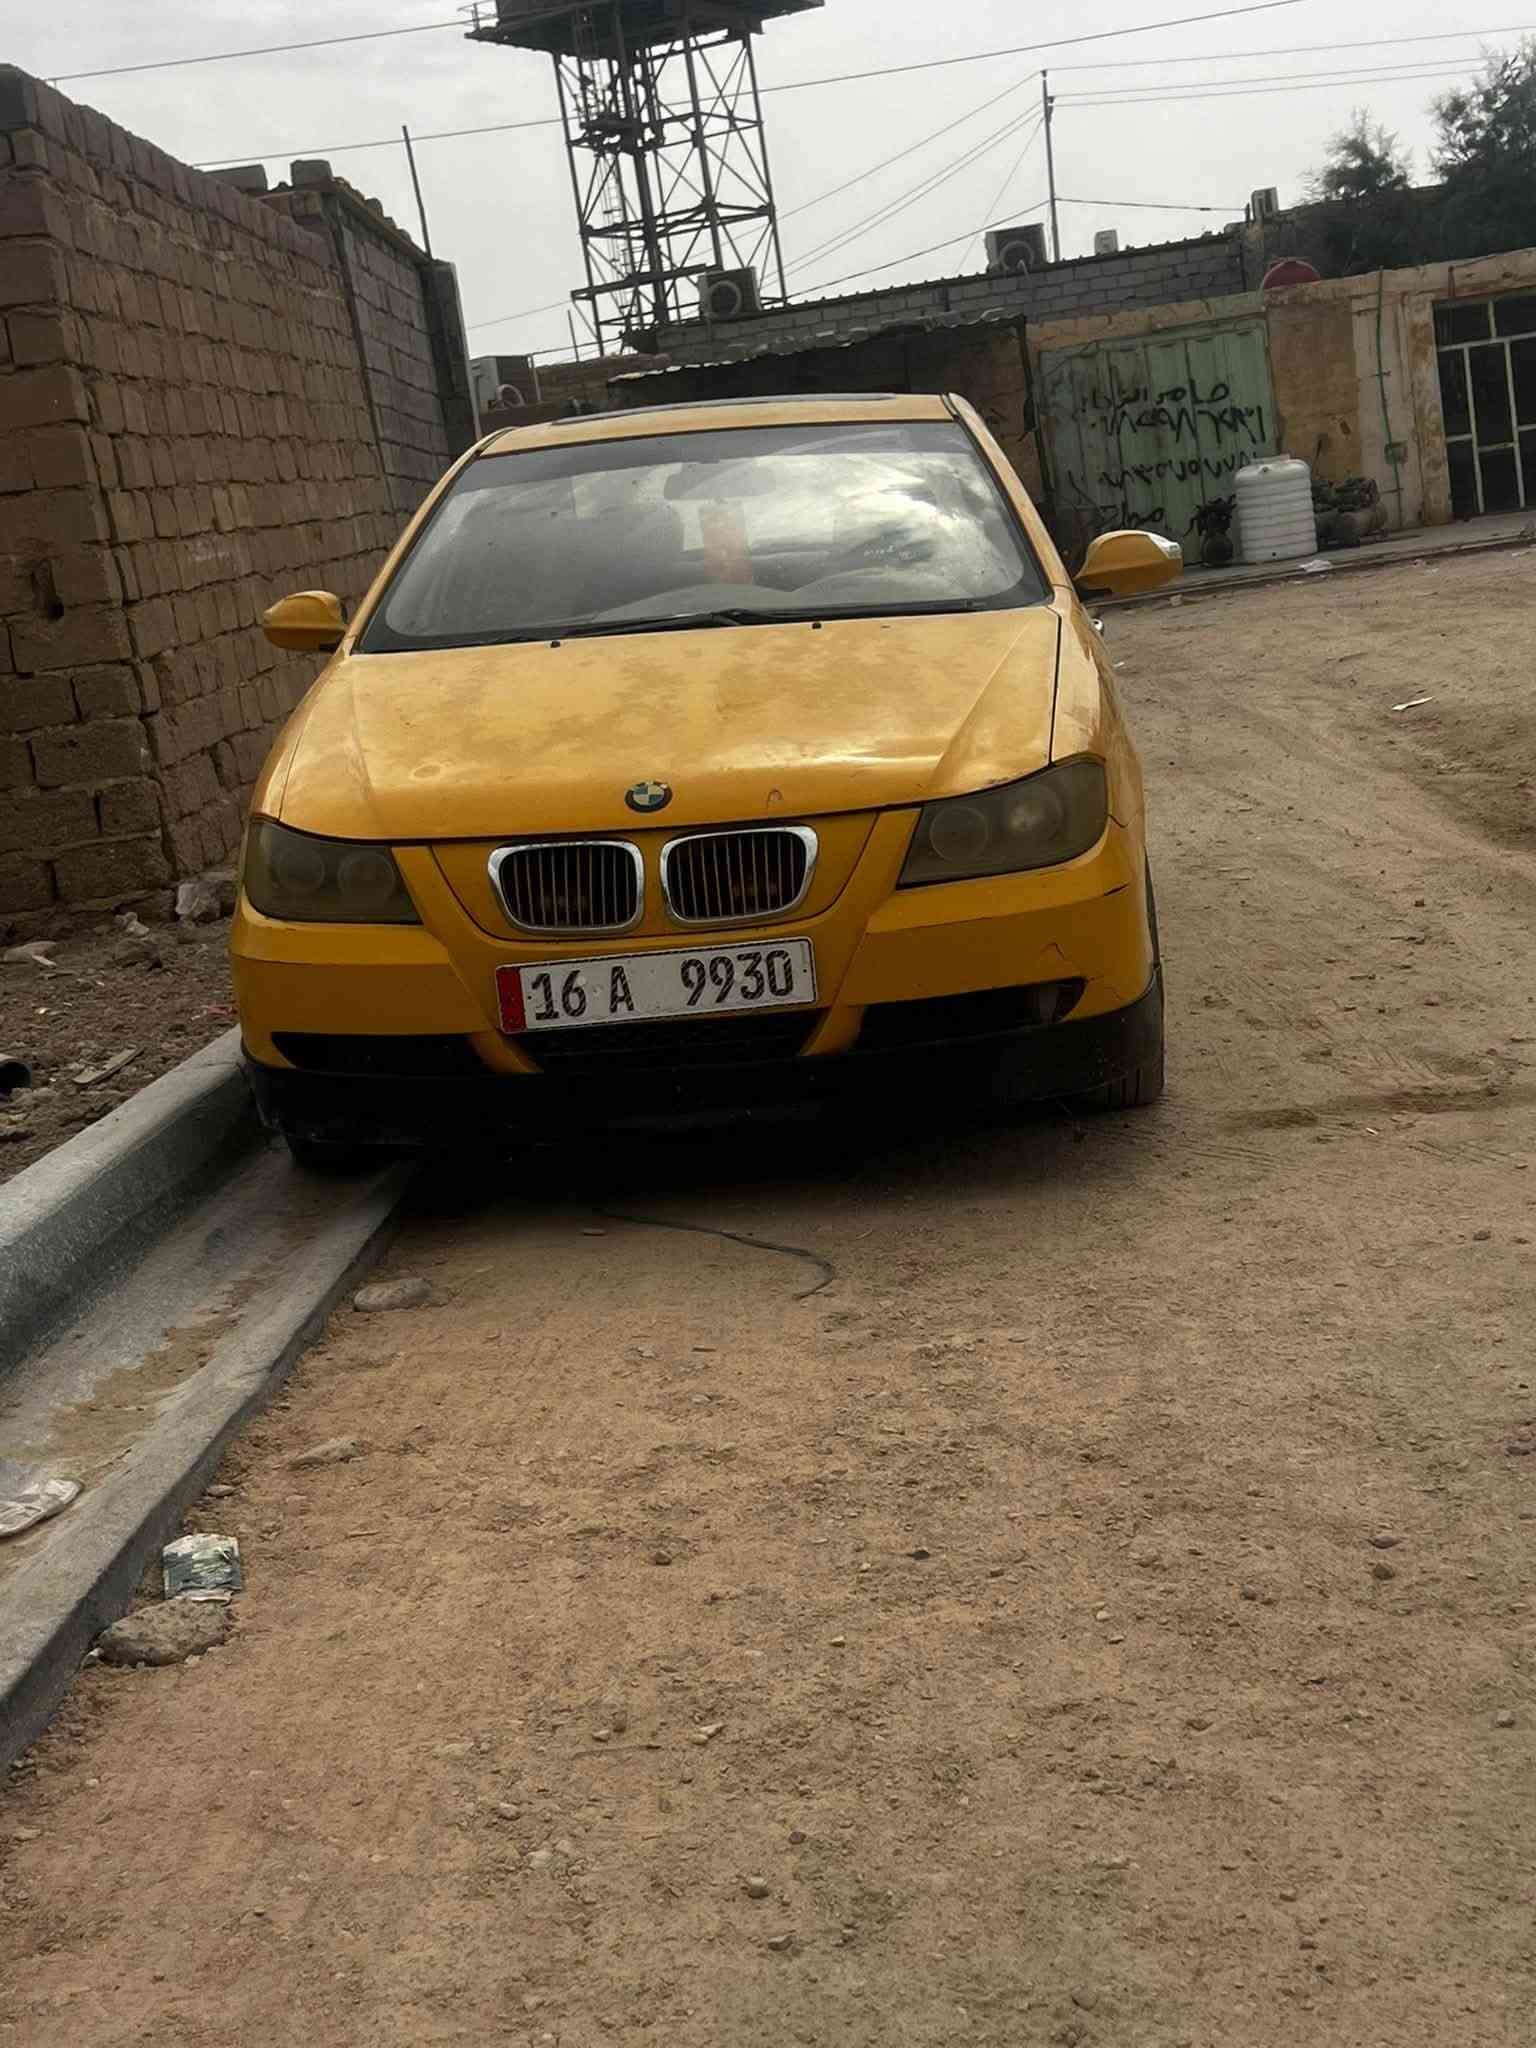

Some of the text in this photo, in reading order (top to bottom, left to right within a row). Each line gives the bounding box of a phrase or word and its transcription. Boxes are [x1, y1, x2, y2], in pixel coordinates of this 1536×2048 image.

[531, 950, 794, 1021] 16 A 9930
